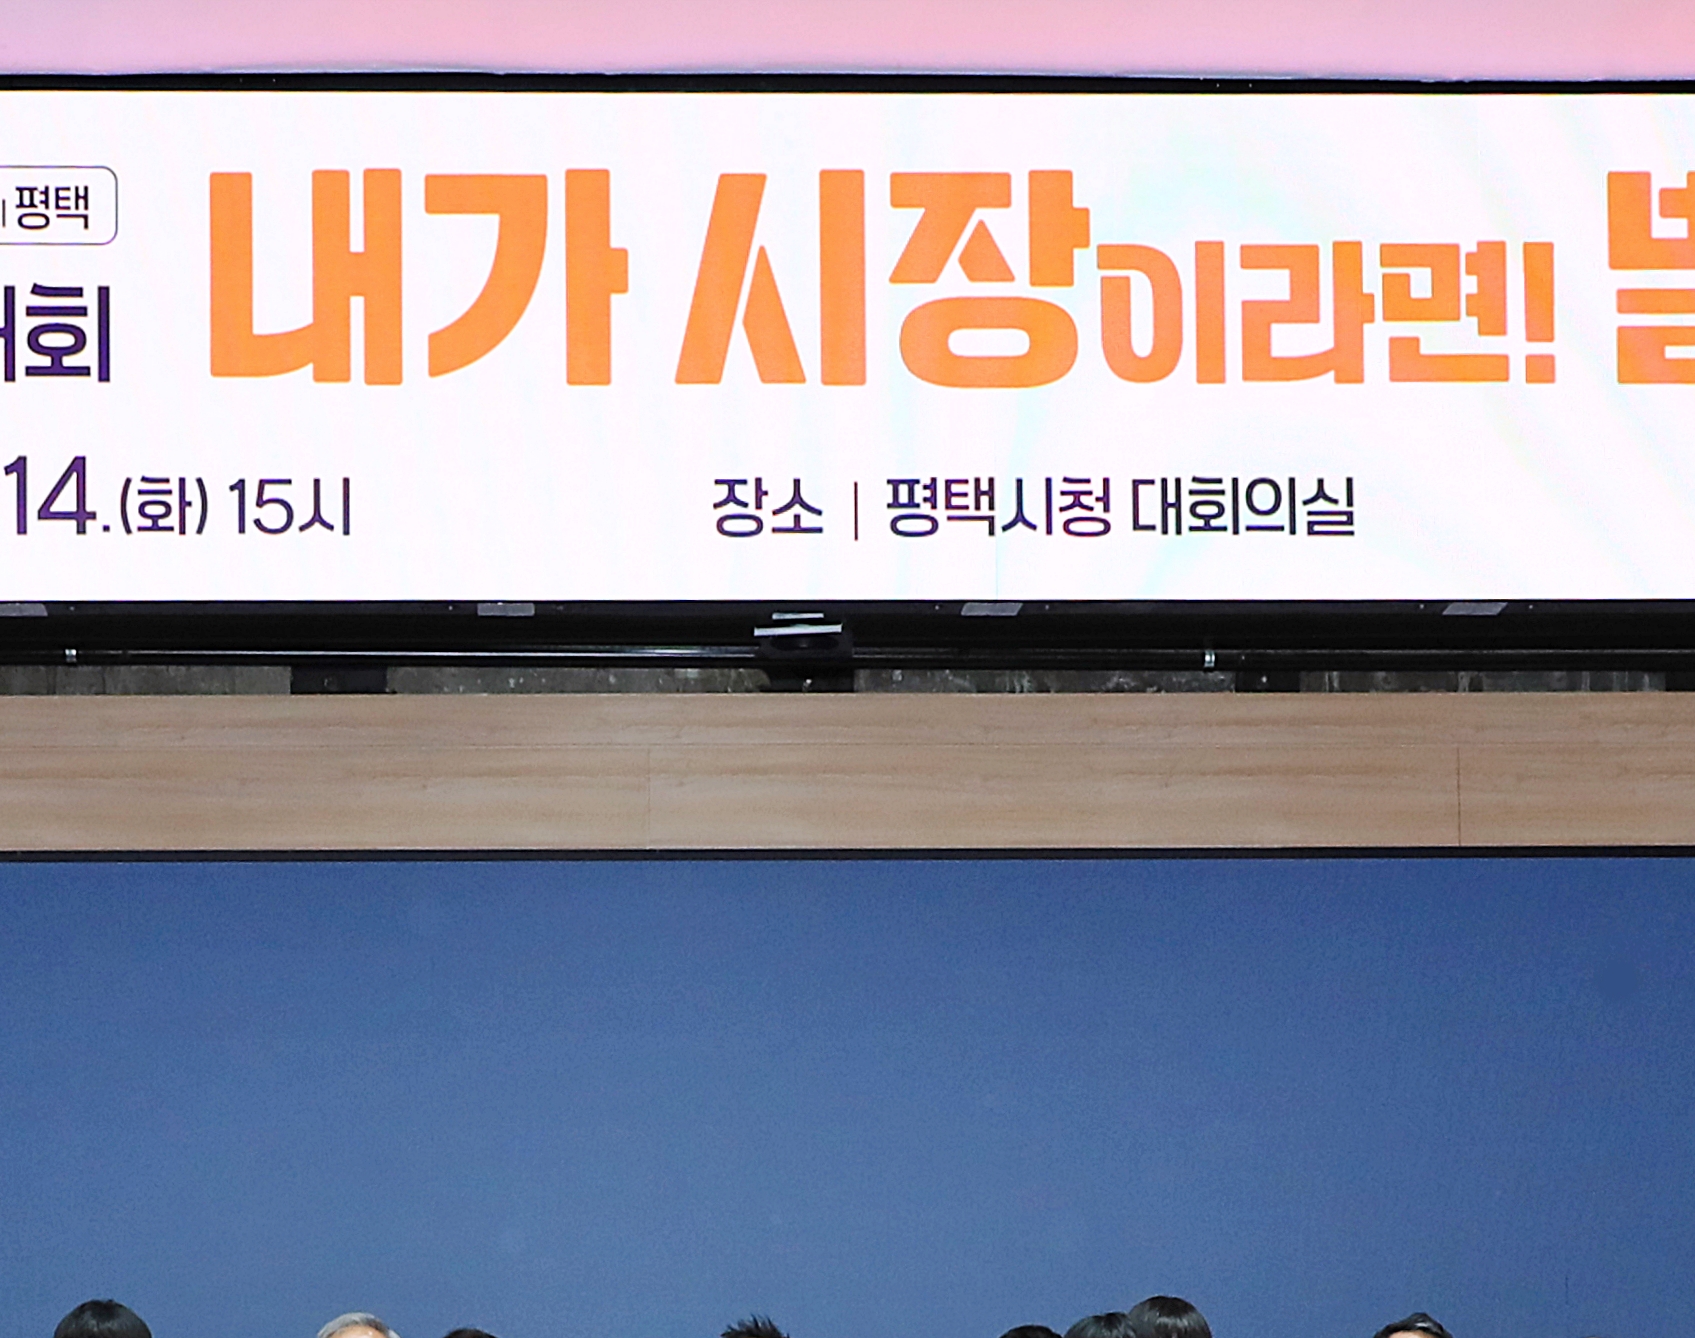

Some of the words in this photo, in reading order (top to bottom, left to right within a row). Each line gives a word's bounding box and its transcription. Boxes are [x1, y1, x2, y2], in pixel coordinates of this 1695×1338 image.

[16, 184, 90, 231] 평택
[209, 168, 629, 387] 내가
[675, 169, 1555, 388] 시장이라면!
[227, 476, 352, 537] 15시
[712, 476, 825, 538] 장소
[886, 475, 1112, 540] 평택시청
[1130, 475, 1357, 539] 대회의실
